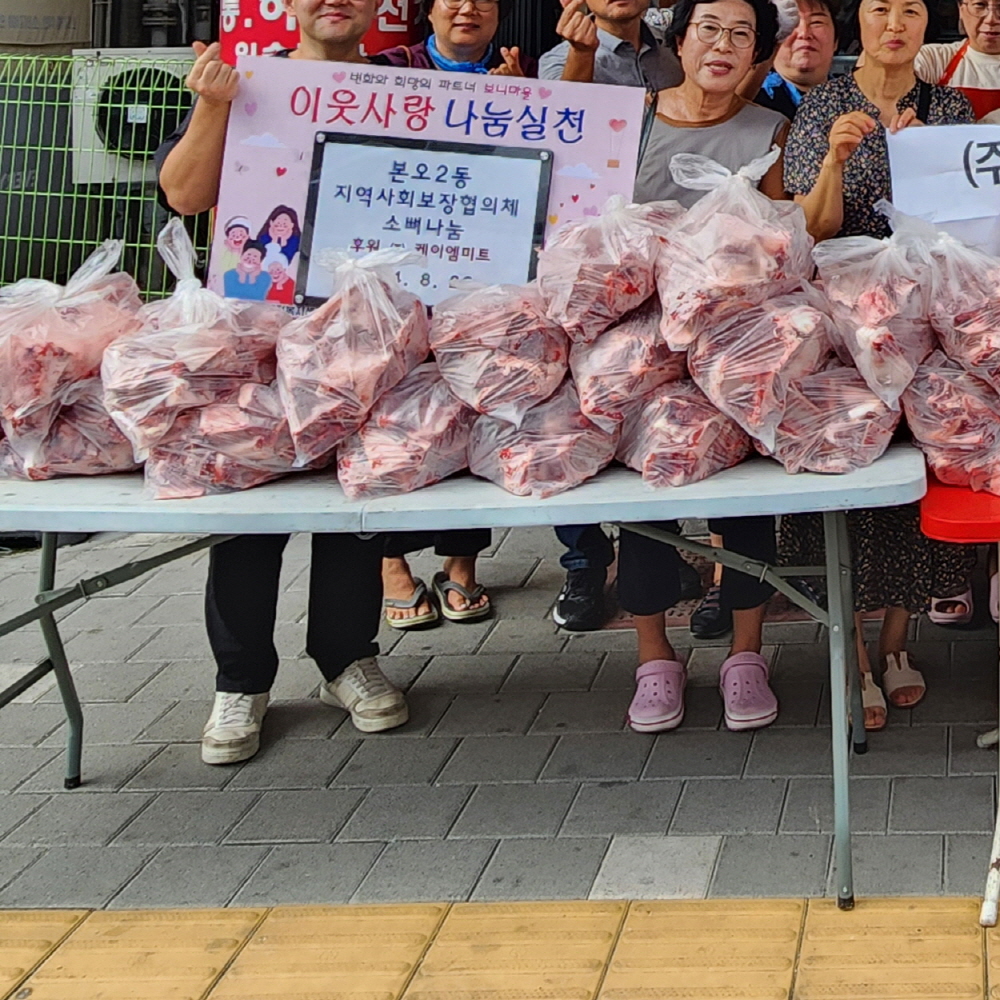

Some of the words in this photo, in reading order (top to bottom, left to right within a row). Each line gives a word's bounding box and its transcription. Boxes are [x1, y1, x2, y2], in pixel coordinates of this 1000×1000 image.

[350, 72, 389, 86] 변화와
[394, 75, 432, 90] 희망의
[438, 80, 477, 92] 파트너
[484, 83, 533, 99] 보니마을
[290, 86, 436, 132] 이웃사랑
[446, 98, 586, 144] 나눔실천
[388, 160, 472, 189] 본오2동
[334, 184, 520, 217] 지역사회보장협의체
[350, 237, 381, 253] 후원
[415, 243, 491, 262] 케이엠미트
